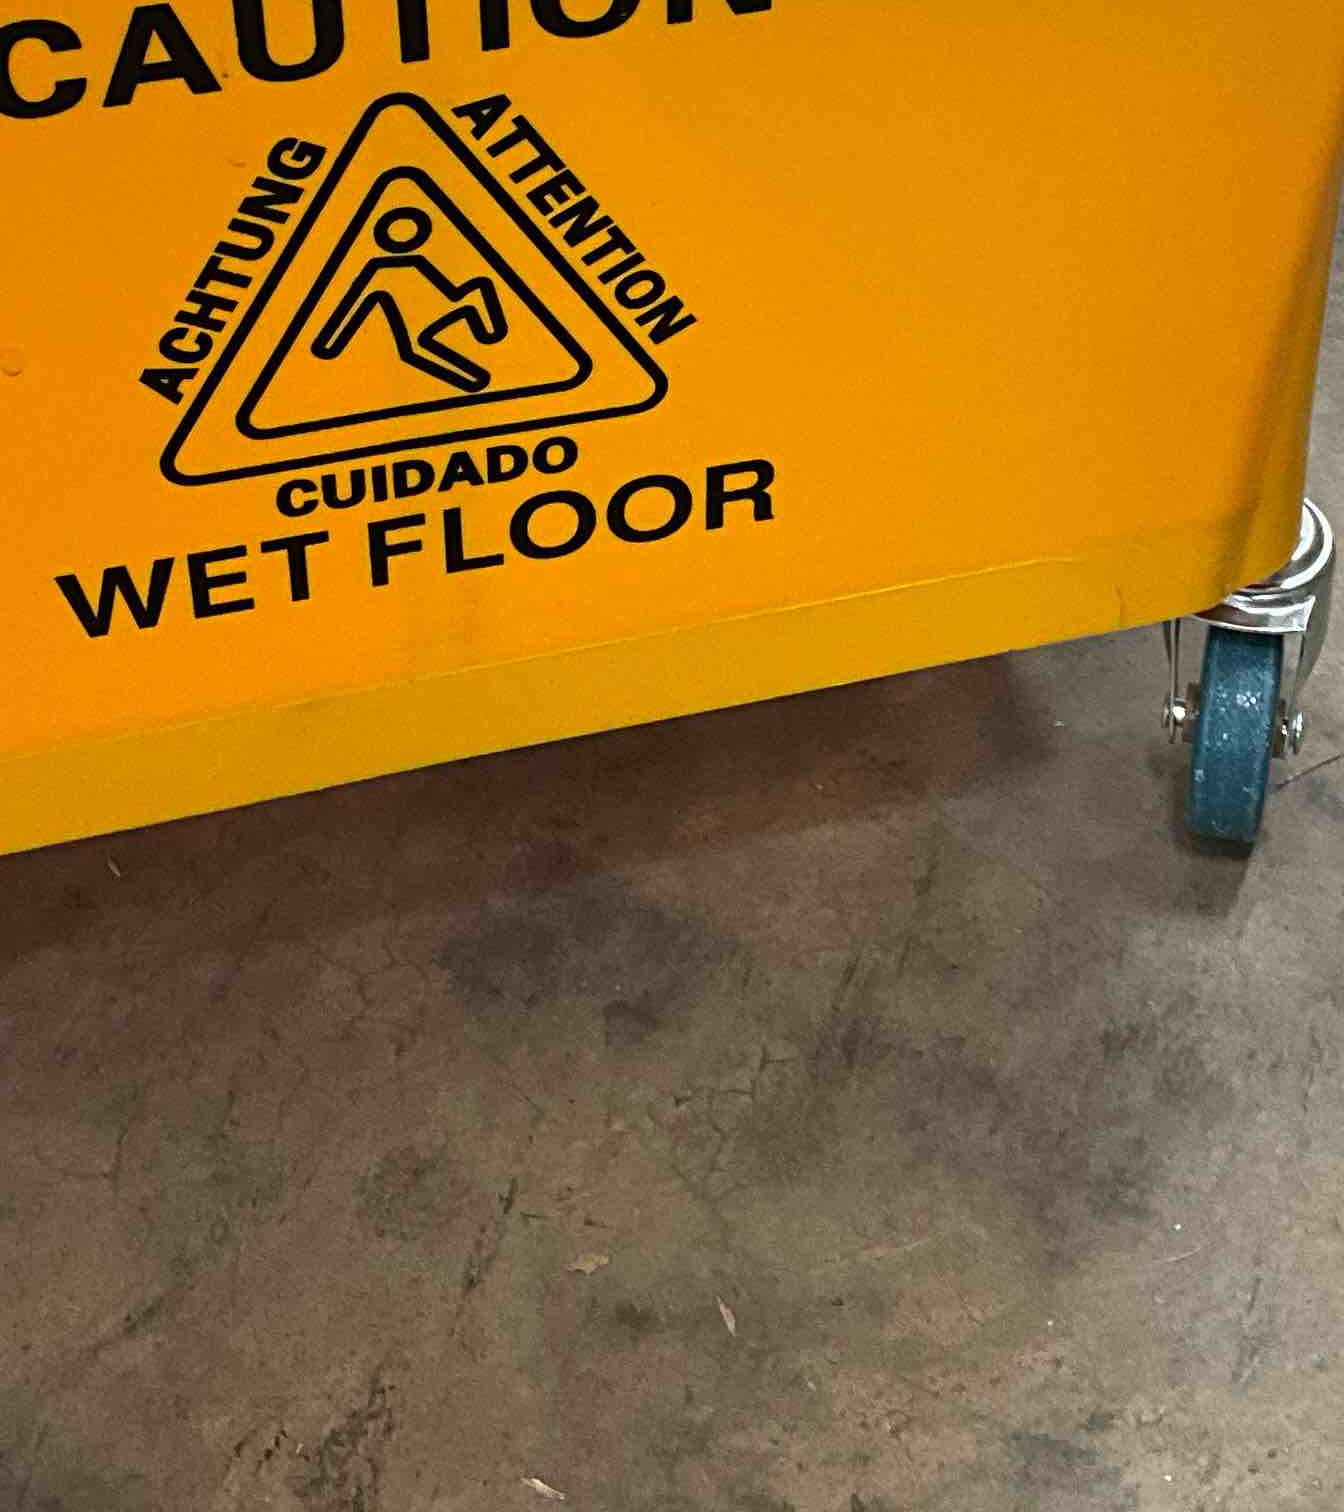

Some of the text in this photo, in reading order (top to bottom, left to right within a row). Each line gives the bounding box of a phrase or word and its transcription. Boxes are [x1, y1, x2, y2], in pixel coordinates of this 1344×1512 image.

[139, 137, 327, 405] ACHTUNG
[451, 93, 697, 345] ATTENTION
[54, 459, 775, 638] WET FLOOR
[276, 436, 578, 518] CUIDADO
